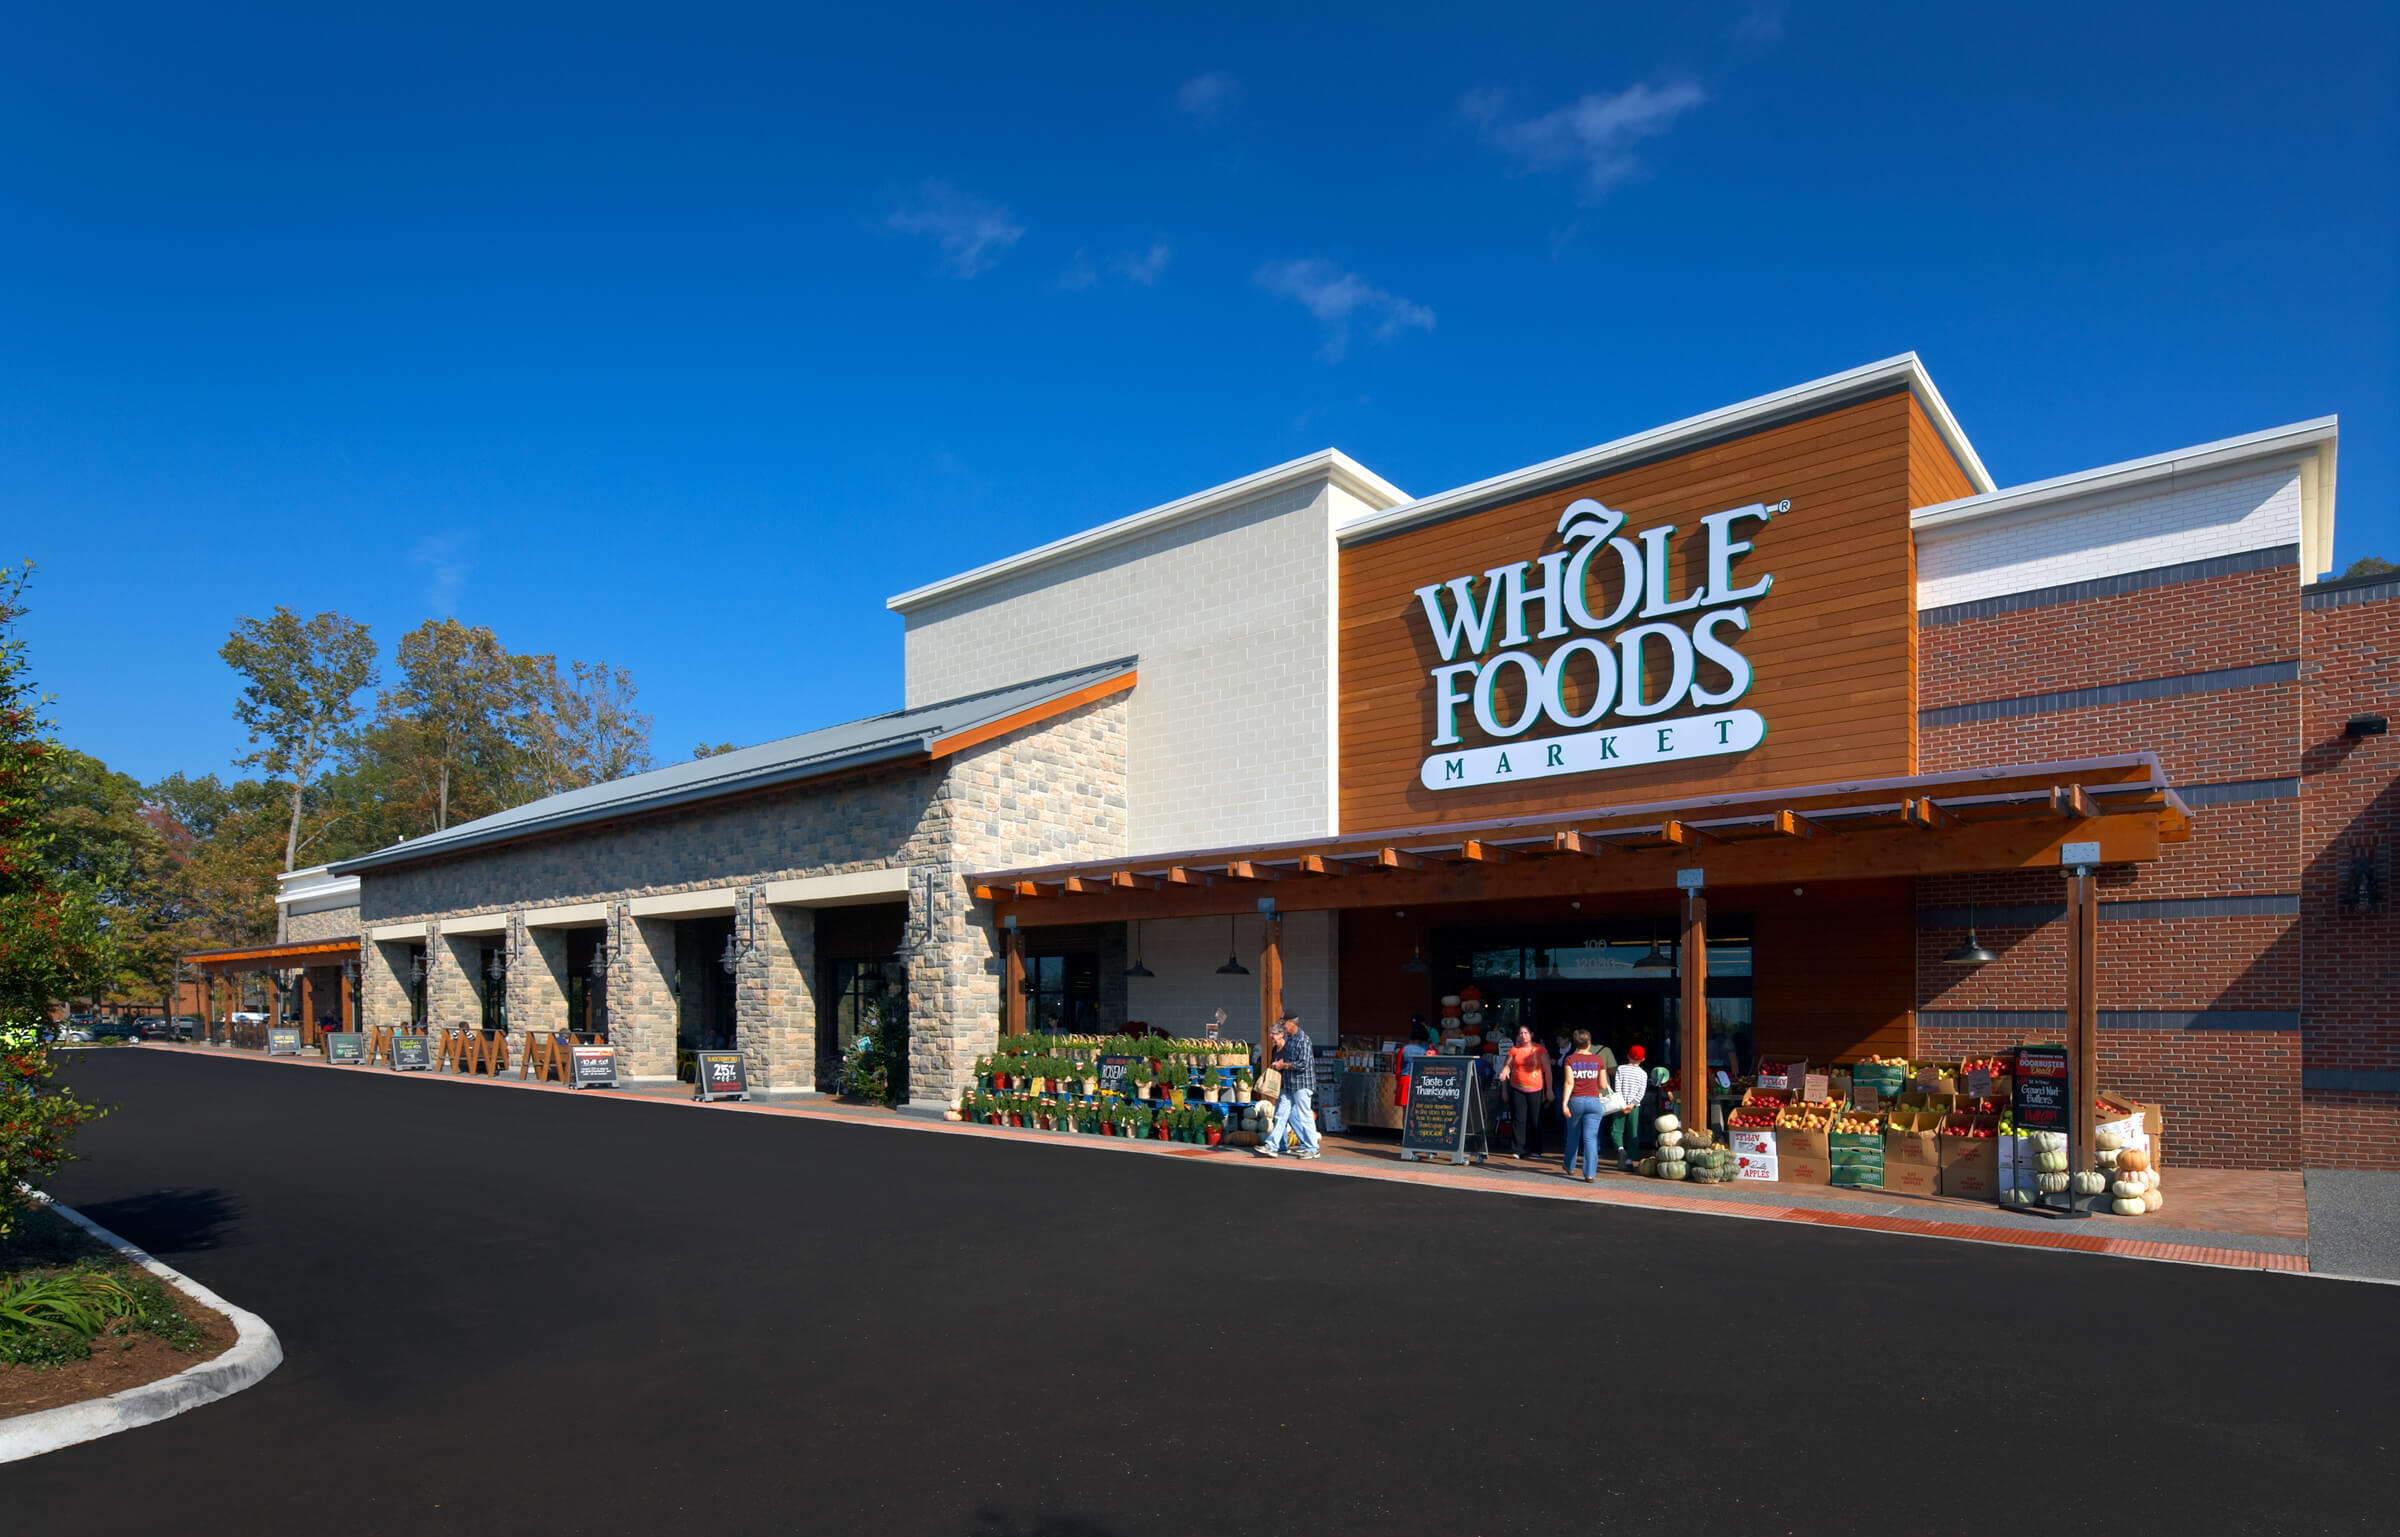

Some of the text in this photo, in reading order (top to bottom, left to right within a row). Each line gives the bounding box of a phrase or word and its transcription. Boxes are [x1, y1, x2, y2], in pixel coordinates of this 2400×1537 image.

[1414, 498, 1774, 661] WHOLE
[1431, 606, 1753, 747] FOODS
[1445, 720, 1734, 780] MARKET
[1572, 1061, 1599, 1070] GREAT
[1420, 1075, 1457, 1087] Taste of
[1573, 1070, 1599, 1079] CATCH
[1415, 1085, 1460, 1099] Thanksgiving
[1744, 1169, 1770, 1179] APPLES
